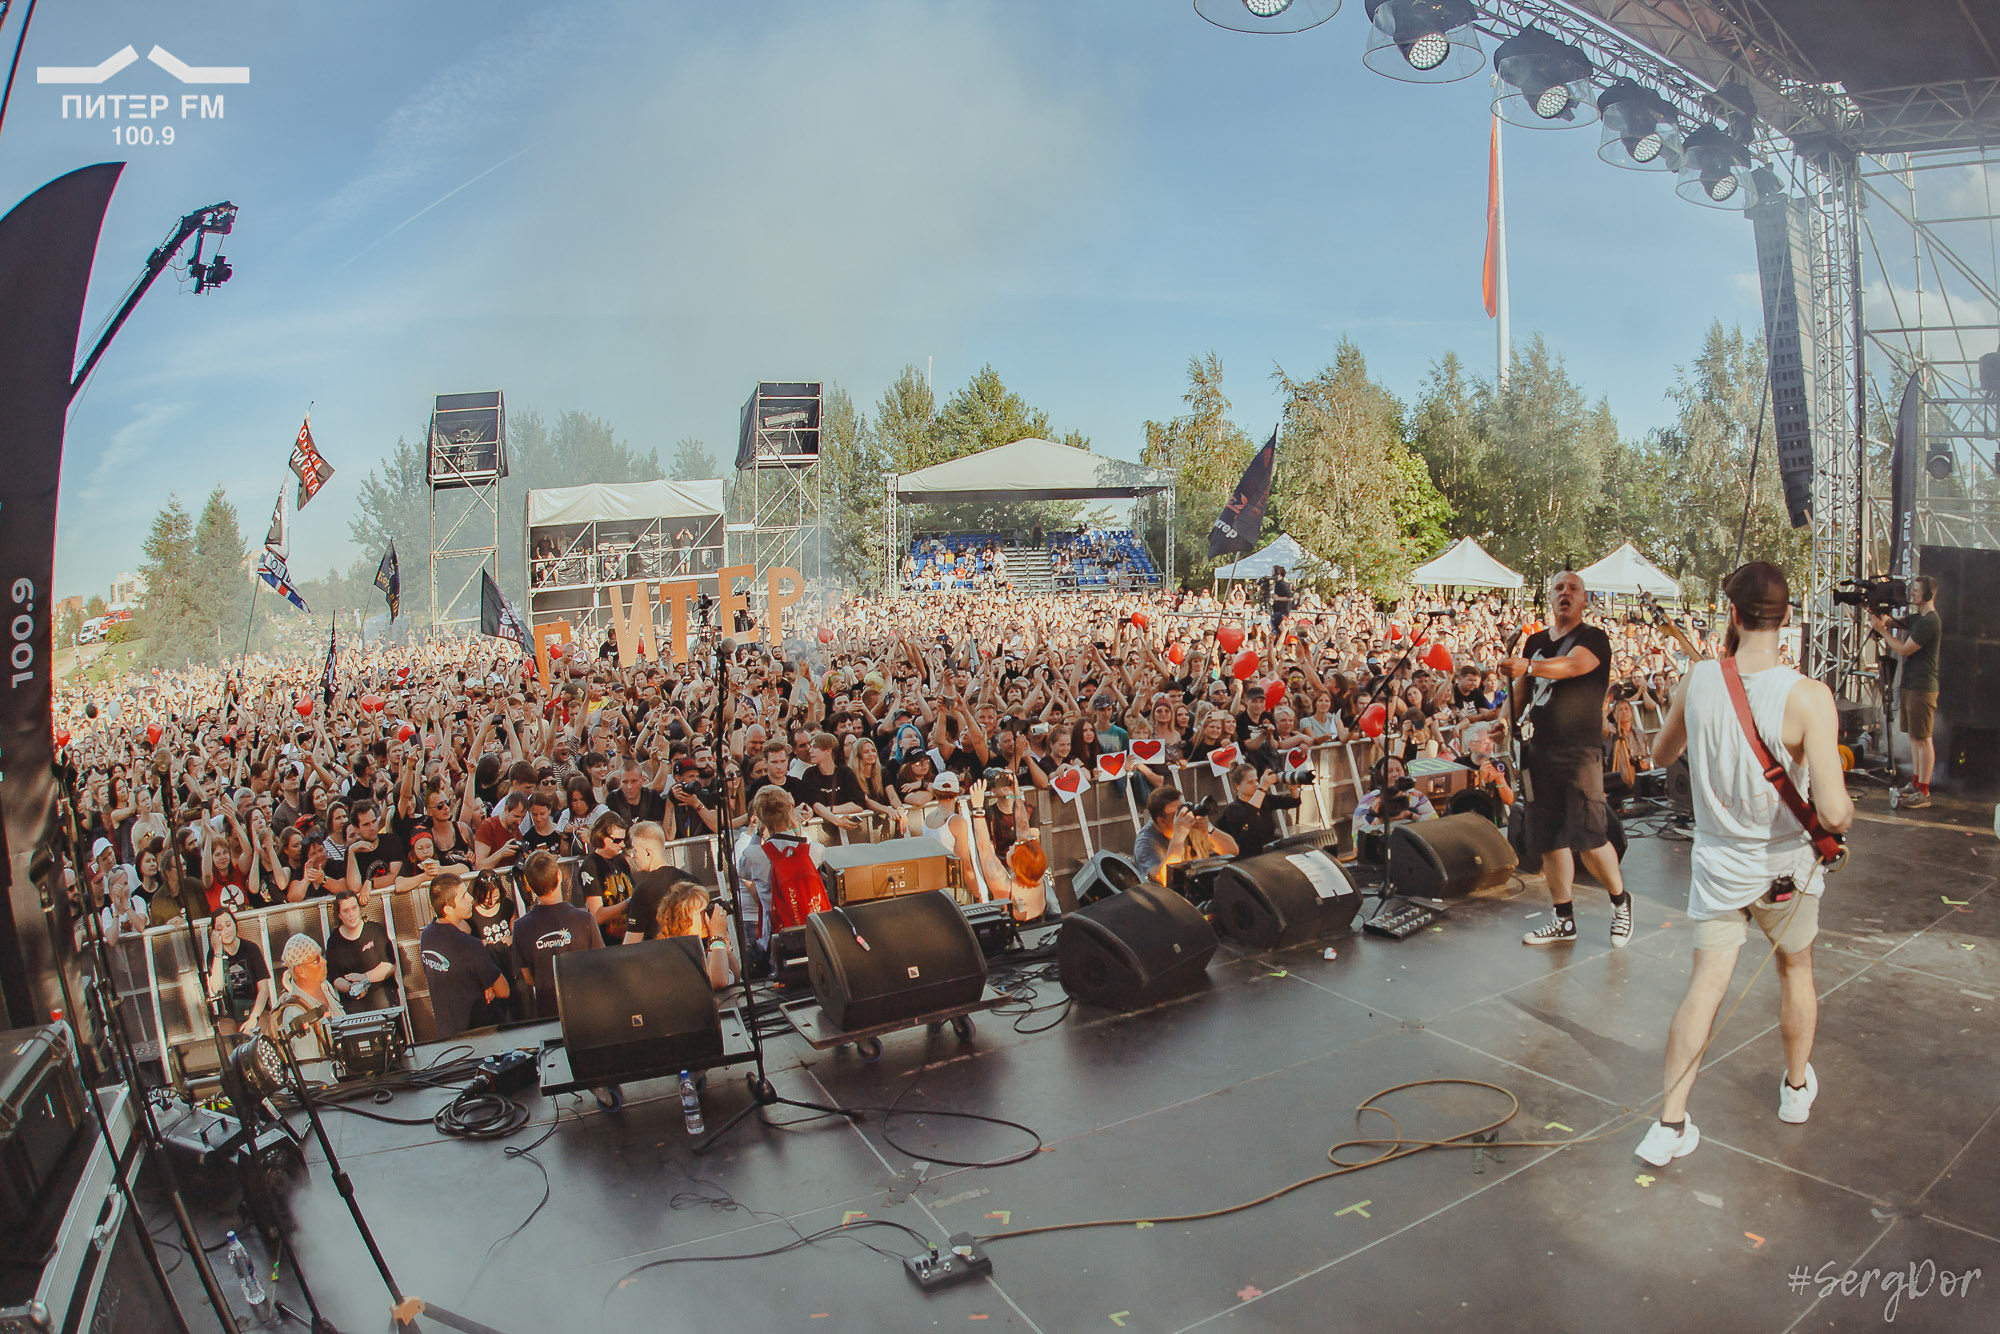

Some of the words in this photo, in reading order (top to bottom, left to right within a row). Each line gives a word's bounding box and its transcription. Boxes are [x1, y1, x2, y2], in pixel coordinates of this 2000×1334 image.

[11, 577, 34, 688] 100.9
[533, 563, 805, 698] ПИТЕР
[536, 938, 571, 949] Сириус
